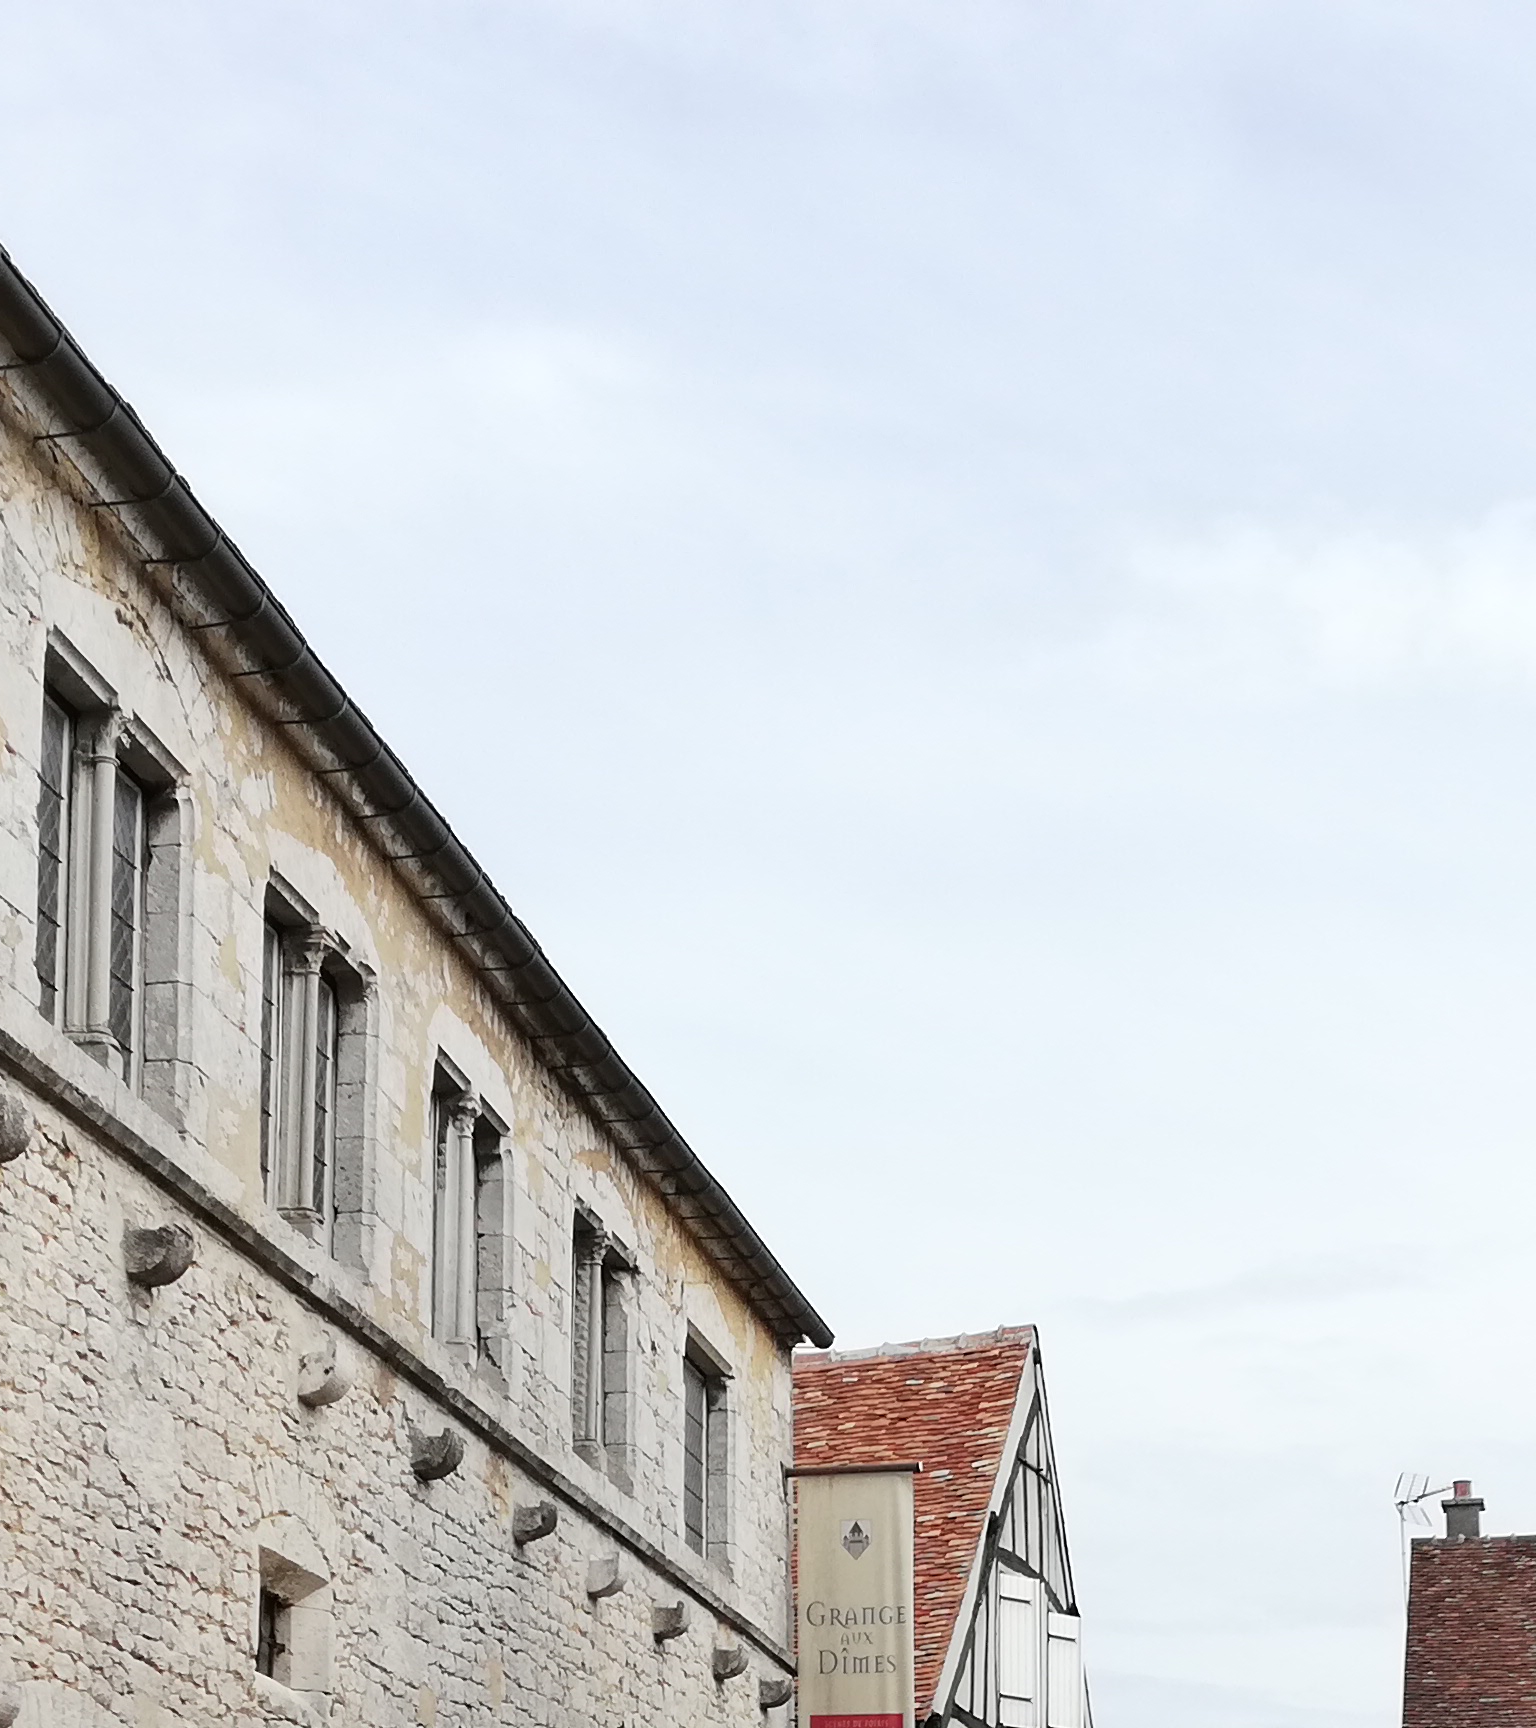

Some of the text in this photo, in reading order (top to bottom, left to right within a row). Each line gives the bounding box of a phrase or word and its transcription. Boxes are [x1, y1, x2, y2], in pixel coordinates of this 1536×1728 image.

[805, 1600, 907, 1630] GRANGE
[840, 1631, 874, 1646] AUX
[818, 1647, 897, 1675] DÎMES
